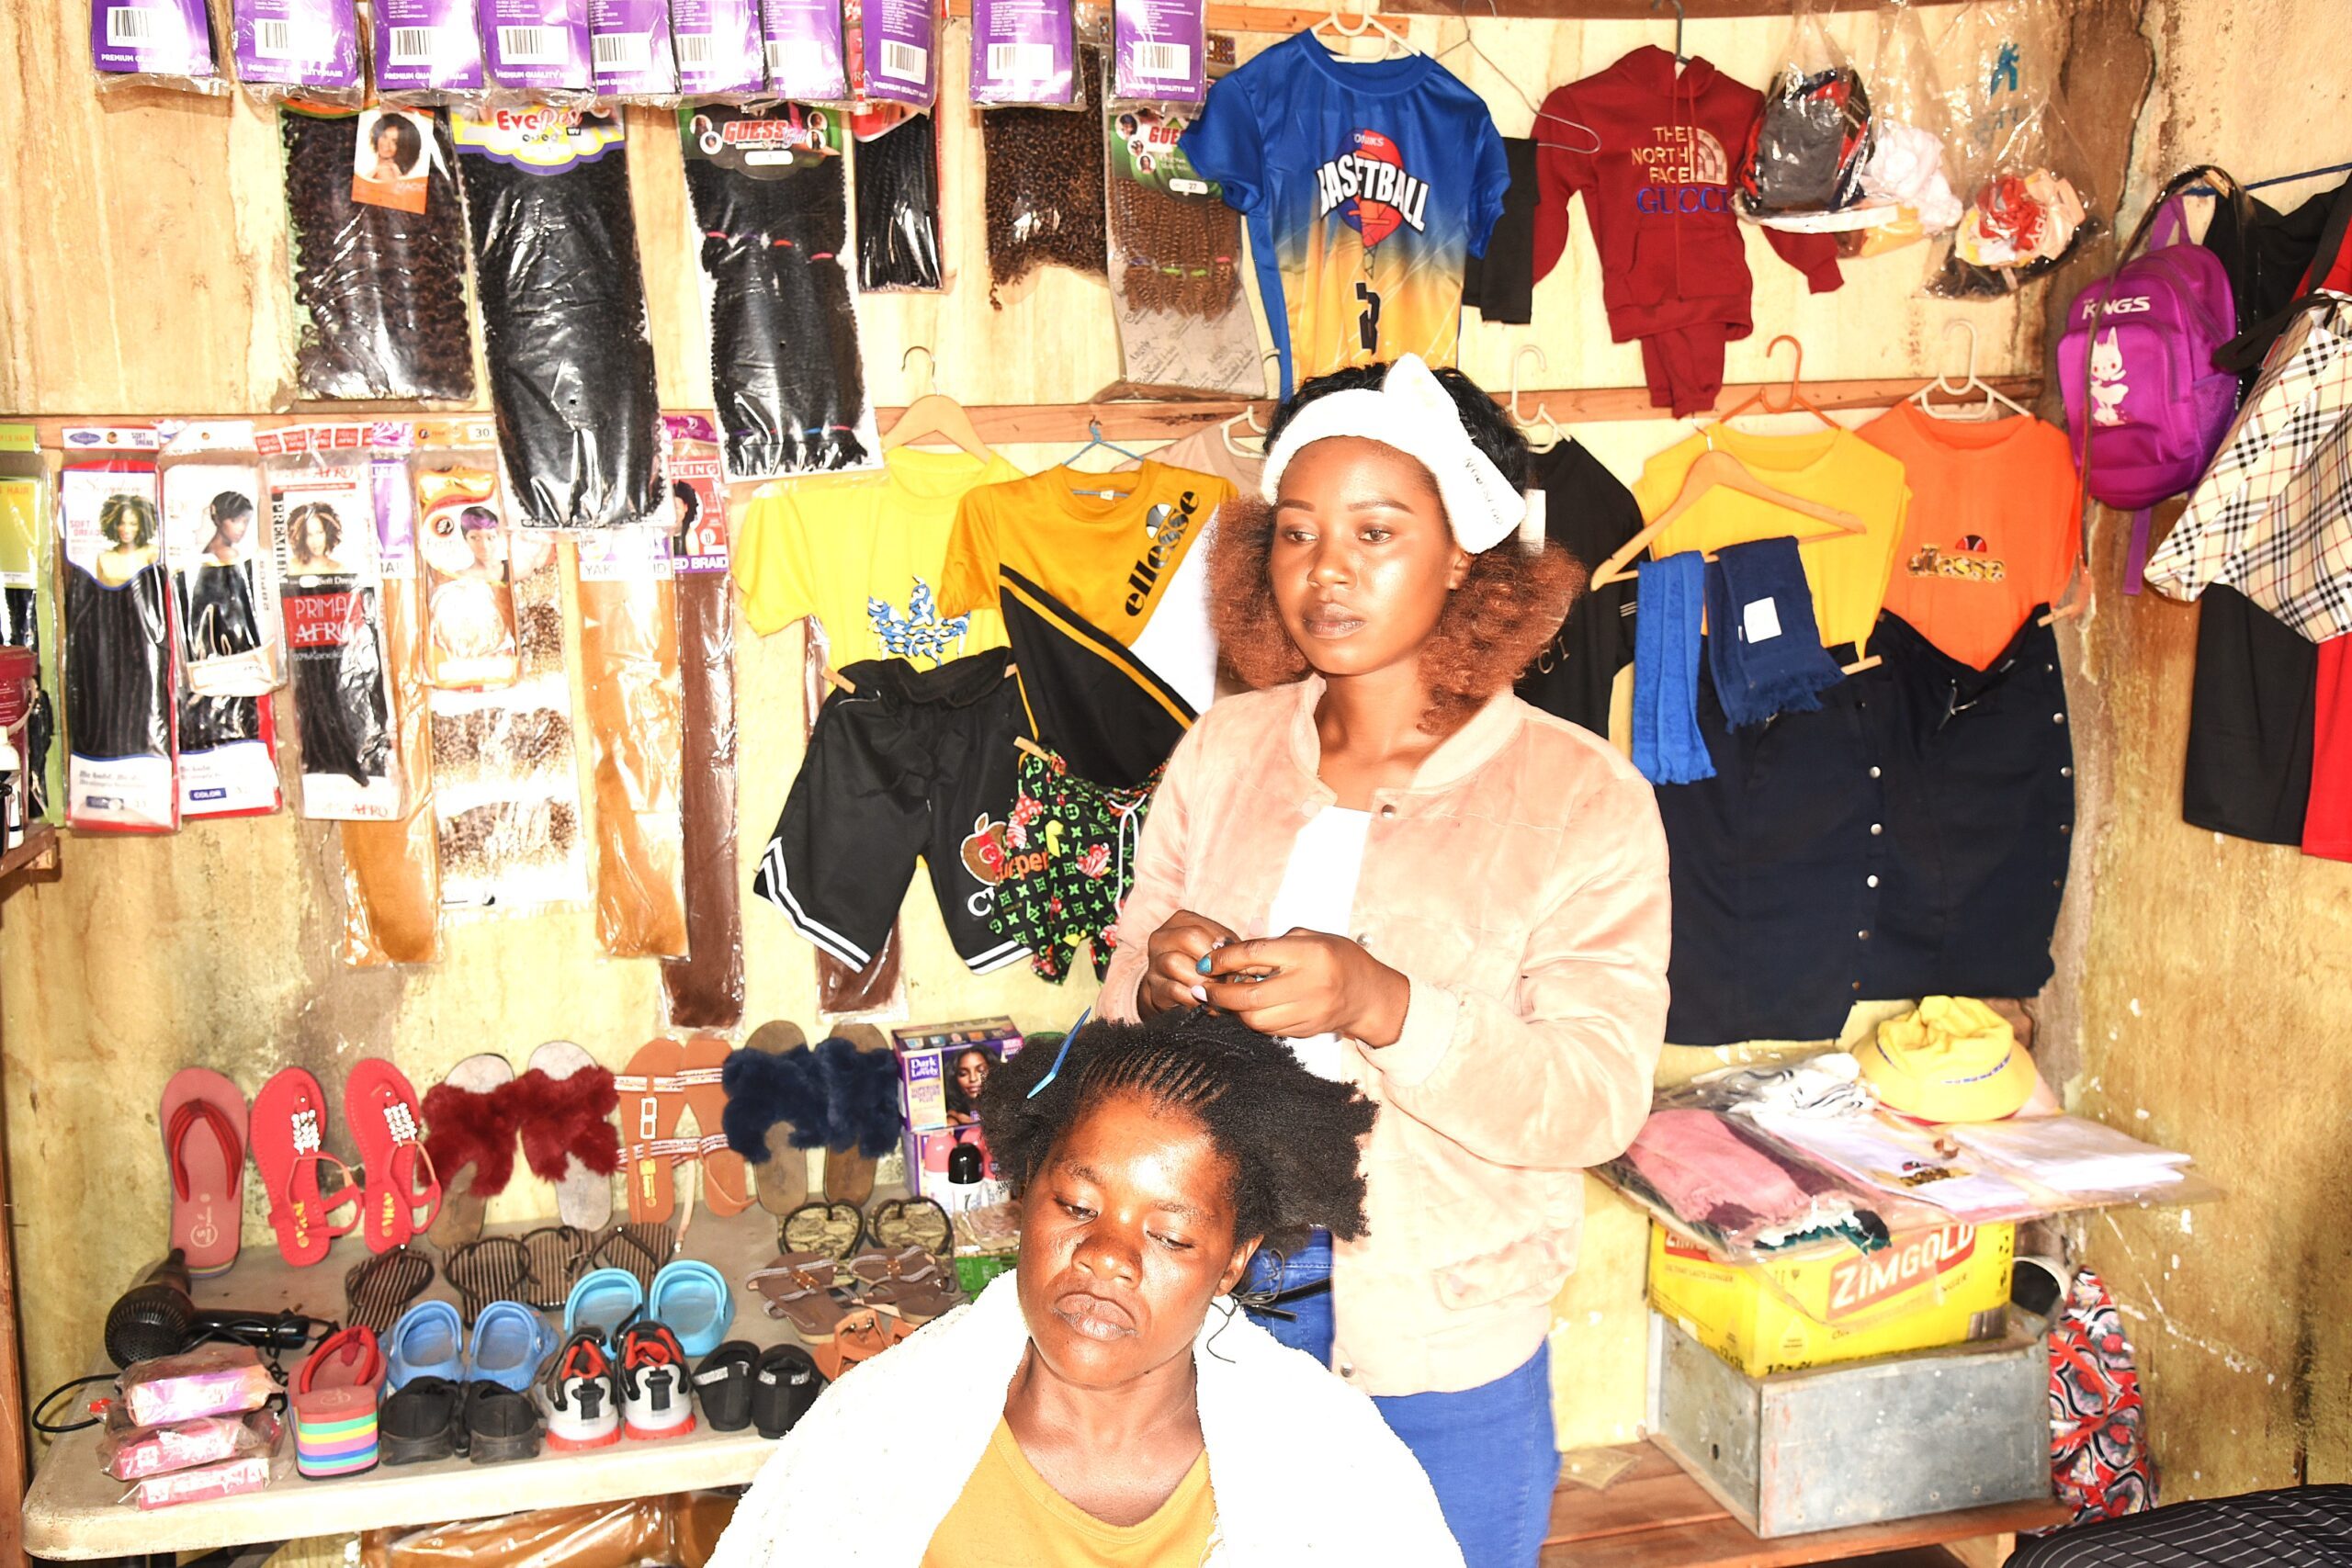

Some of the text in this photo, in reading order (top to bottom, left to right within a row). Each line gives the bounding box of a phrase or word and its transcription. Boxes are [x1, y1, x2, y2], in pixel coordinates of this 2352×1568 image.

[101, 53, 135, 62] PREMIUM
[526, 72, 560, 80] QUALITY
[874, 81, 901, 91] PREMIUM
[901, 85, 919, 96] QUALITY
[723, 120, 789, 144] GUESS
[1149, 126, 1186, 145] GUE
[1653, 126, 1688, 141] THE
[1631, 147, 1689, 165] NORTH
[1649, 166, 1690, 184] FACE
[1636, 187, 1729, 213] GUCCI
[2081, 296, 2151, 321] KNGS
[476, 428, 490, 437] 30
[671, 464, 718, 476] RLING
[1125, 491, 1199, 616] ellesse
[691, 557, 729, 570] BRAID
[294, 596, 348, 619] PRIMA
[193, 790, 221, 798] COLOR
[910, 1056, 936, 1069] Dark
[910, 1066, 939, 1078] Lovely
[1831, 1224, 1975, 1310] ZIMGOLD
